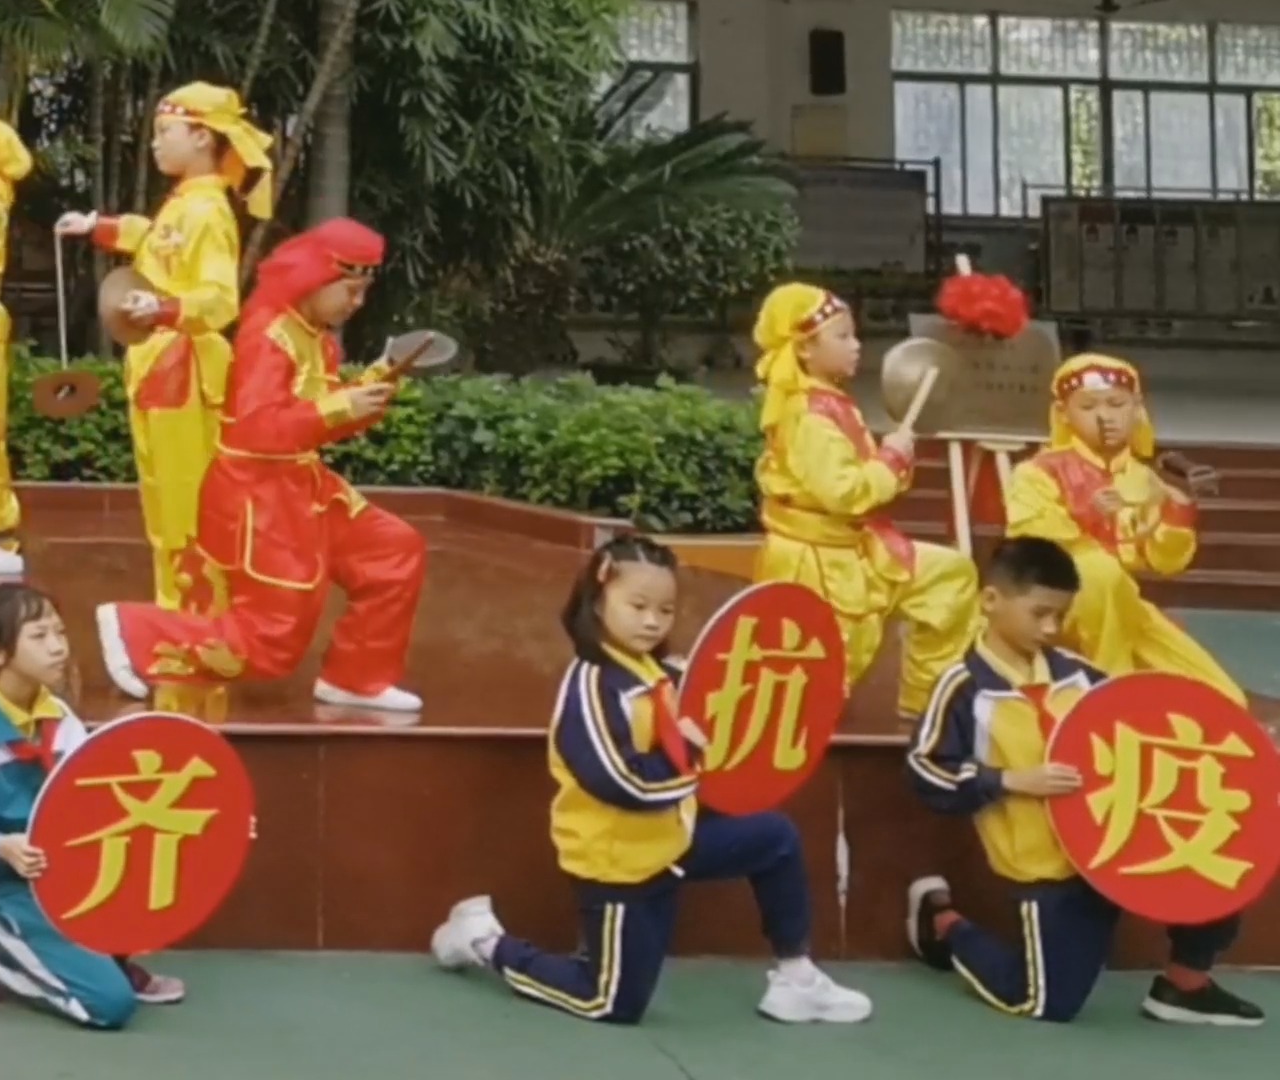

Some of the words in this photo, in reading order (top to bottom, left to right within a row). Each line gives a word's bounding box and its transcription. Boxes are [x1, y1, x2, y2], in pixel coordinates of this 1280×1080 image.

[701, 615, 827, 774] 抗
[61, 749, 220, 920] 齐
[1087, 713, 1255, 890] 疫
